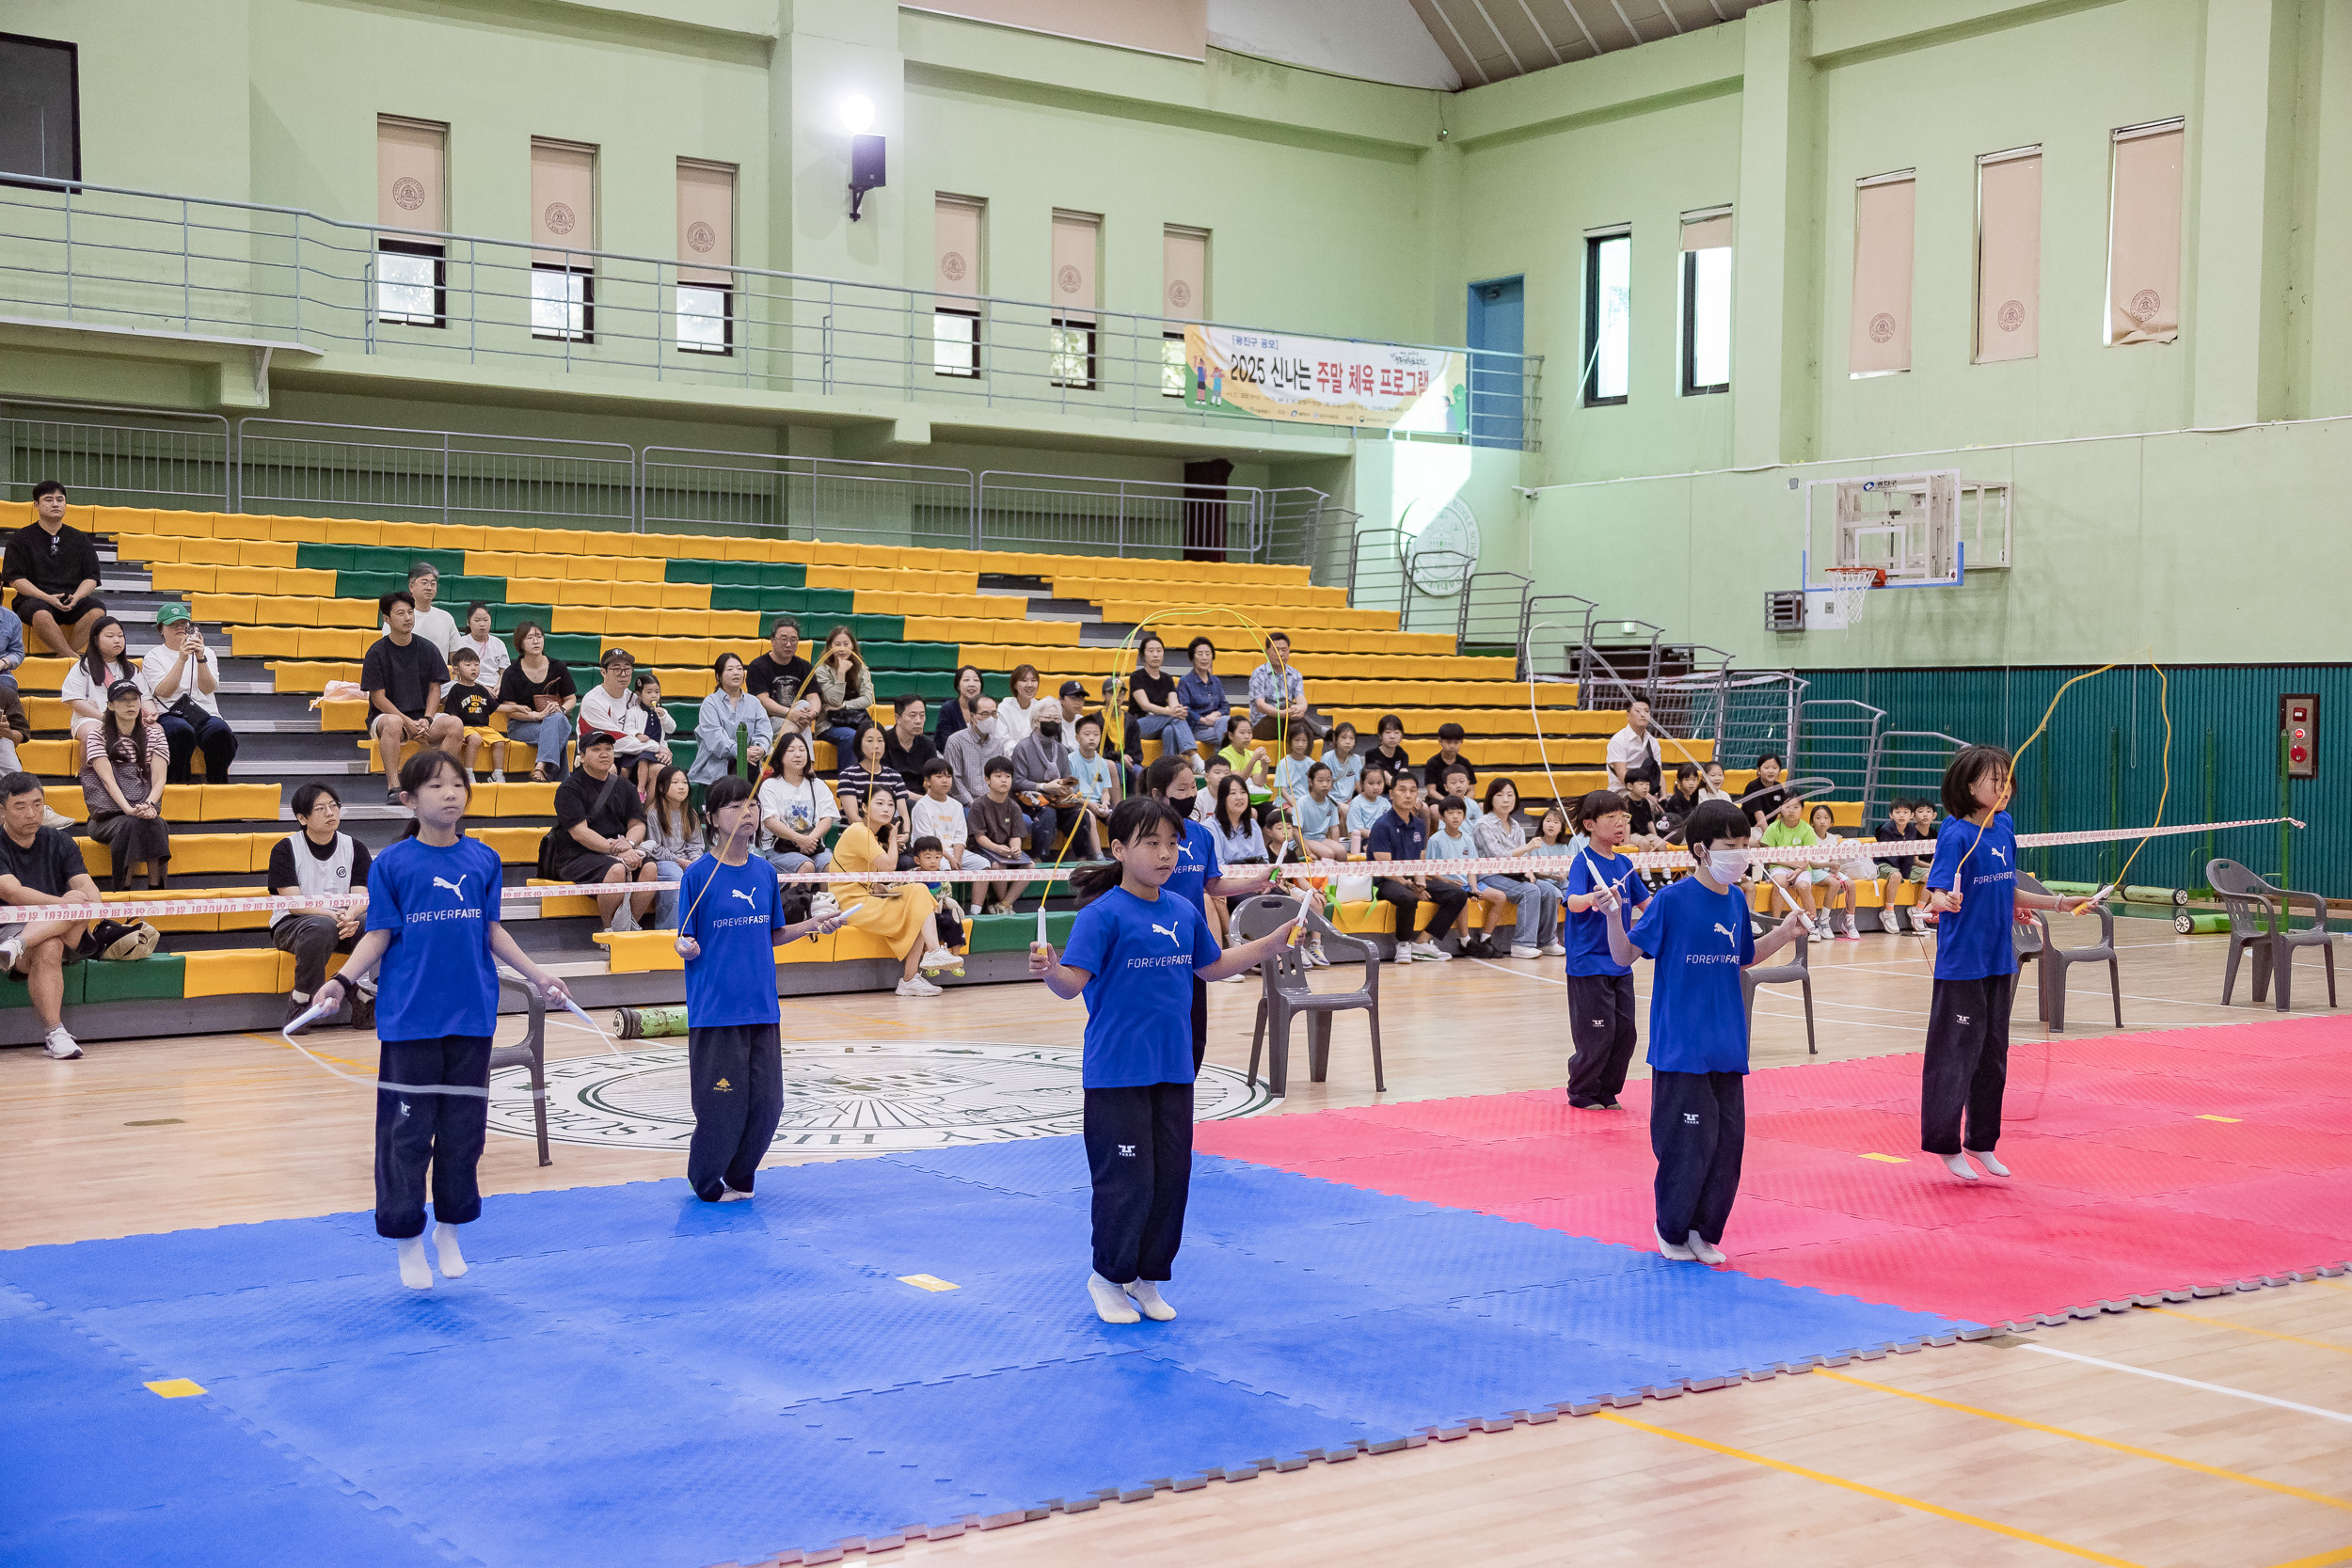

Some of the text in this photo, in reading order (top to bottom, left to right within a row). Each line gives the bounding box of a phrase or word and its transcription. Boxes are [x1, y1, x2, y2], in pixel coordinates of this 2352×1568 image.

[1231, 354, 1265, 385] 2025
[1270, 356, 1311, 391] 신나는
[1316, 361, 1344, 394] 주말
[1348, 364, 1375, 397] 체육
[405, 908, 483, 924] FOREVERFASTE
[1127, 954, 1192, 969] FOREVERFASTE
